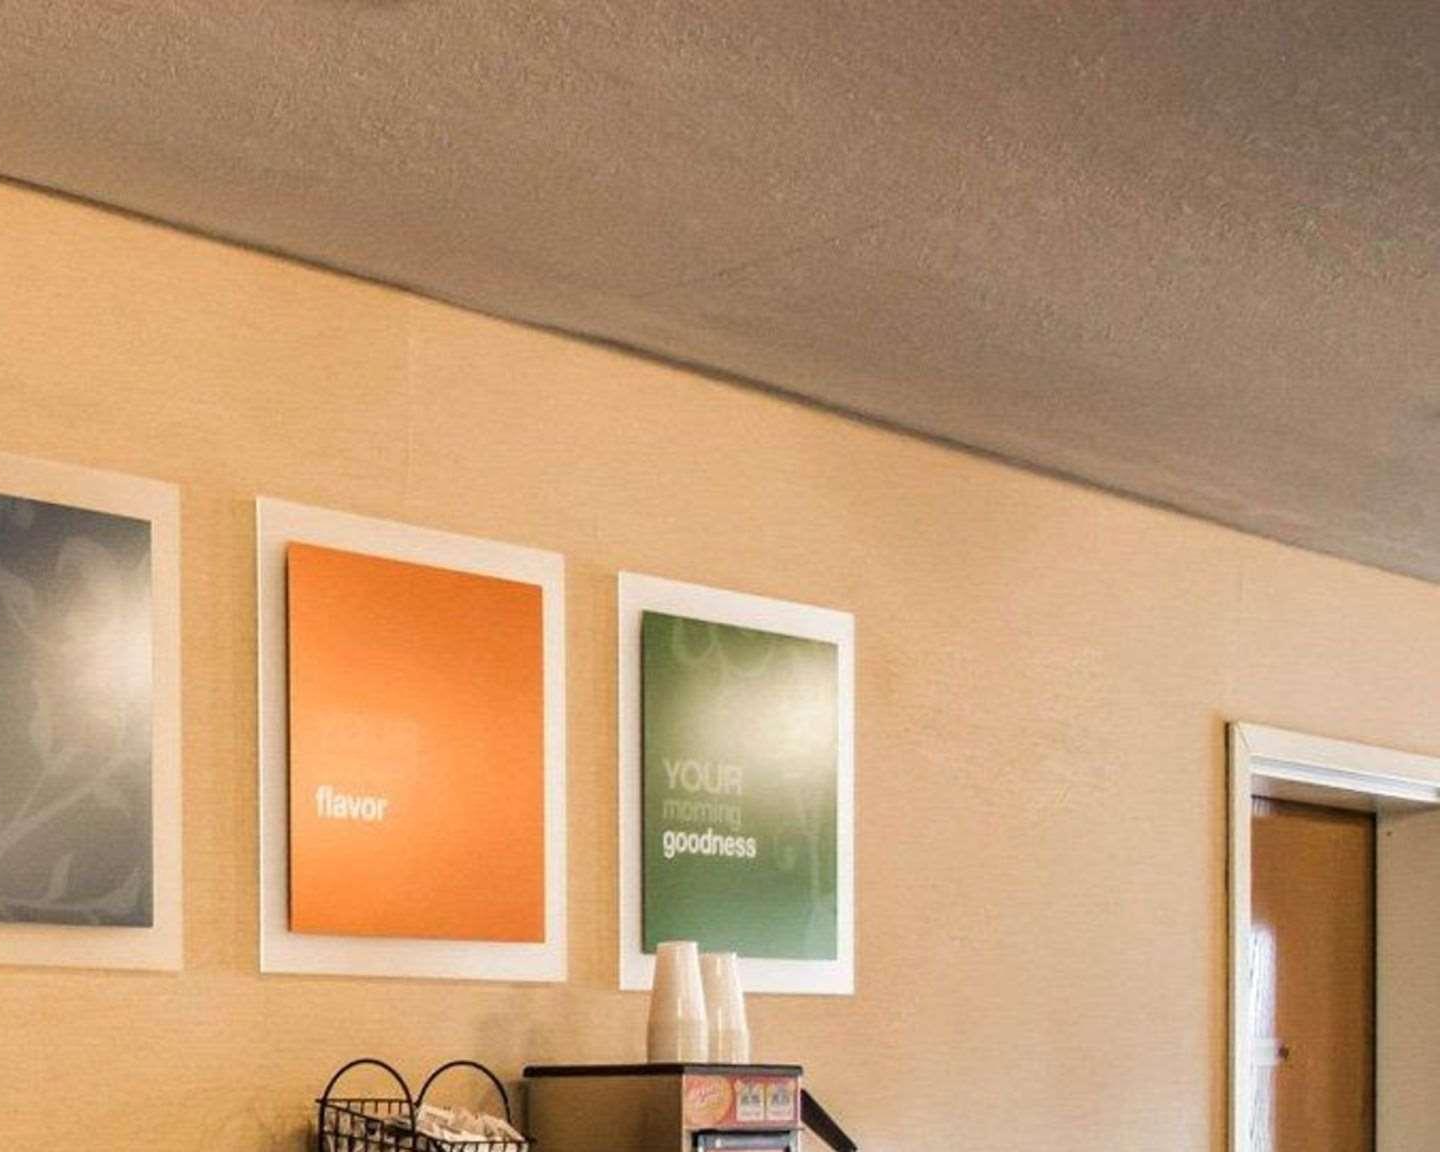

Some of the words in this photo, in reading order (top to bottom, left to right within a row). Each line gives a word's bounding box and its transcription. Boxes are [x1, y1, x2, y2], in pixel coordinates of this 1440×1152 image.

[663, 759, 743, 795] YOUR
[316, 785, 387, 820] flavor
[663, 828, 756, 858] goodness
